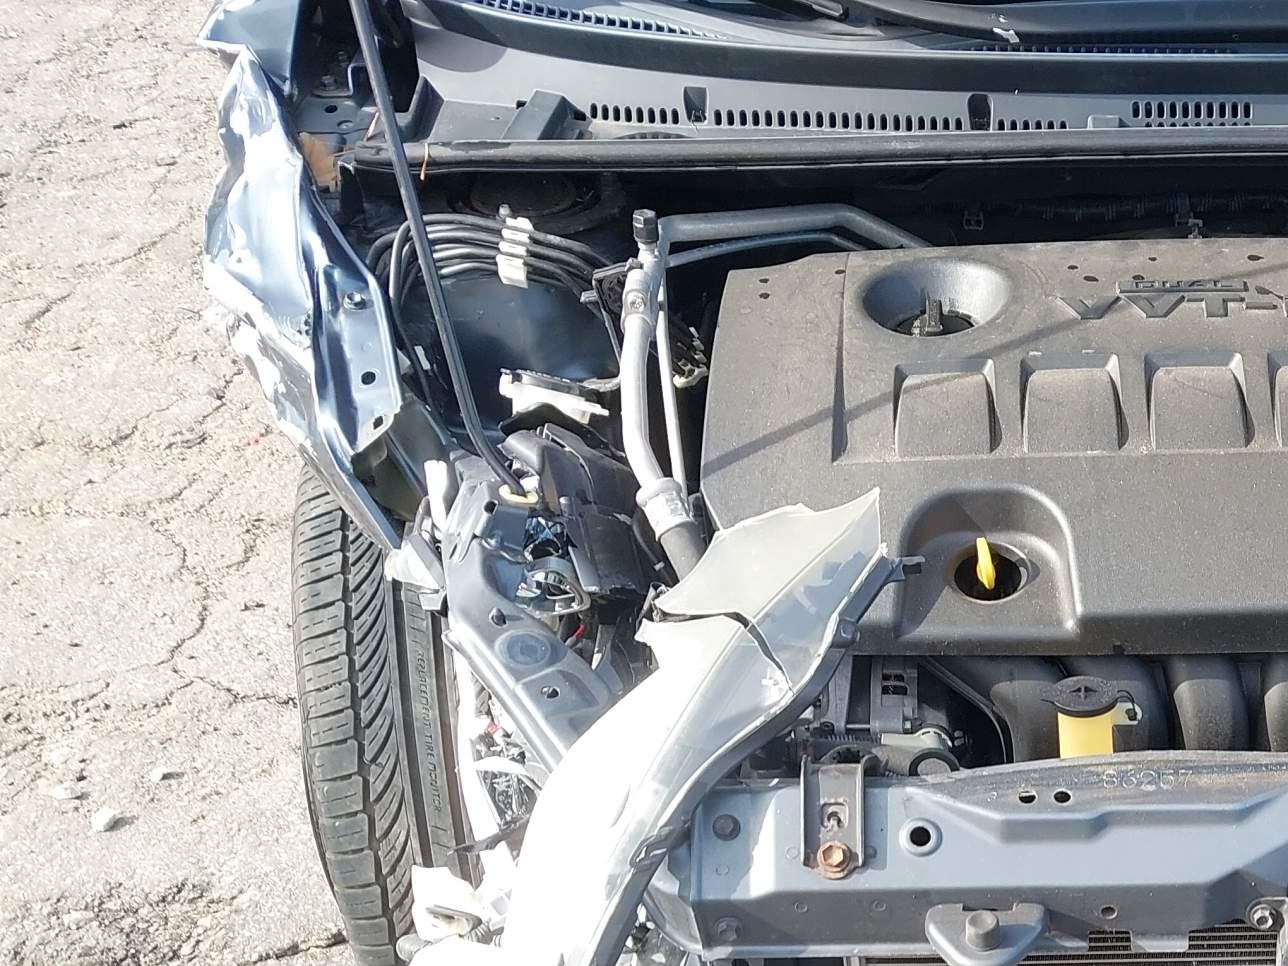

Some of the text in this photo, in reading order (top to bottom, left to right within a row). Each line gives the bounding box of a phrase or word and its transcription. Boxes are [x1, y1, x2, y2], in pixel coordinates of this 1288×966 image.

[1132, 279, 1237, 291] DUAL
[424, 734, 436, 760] TIRE
[428, 761, 442, 813] MONITOR
